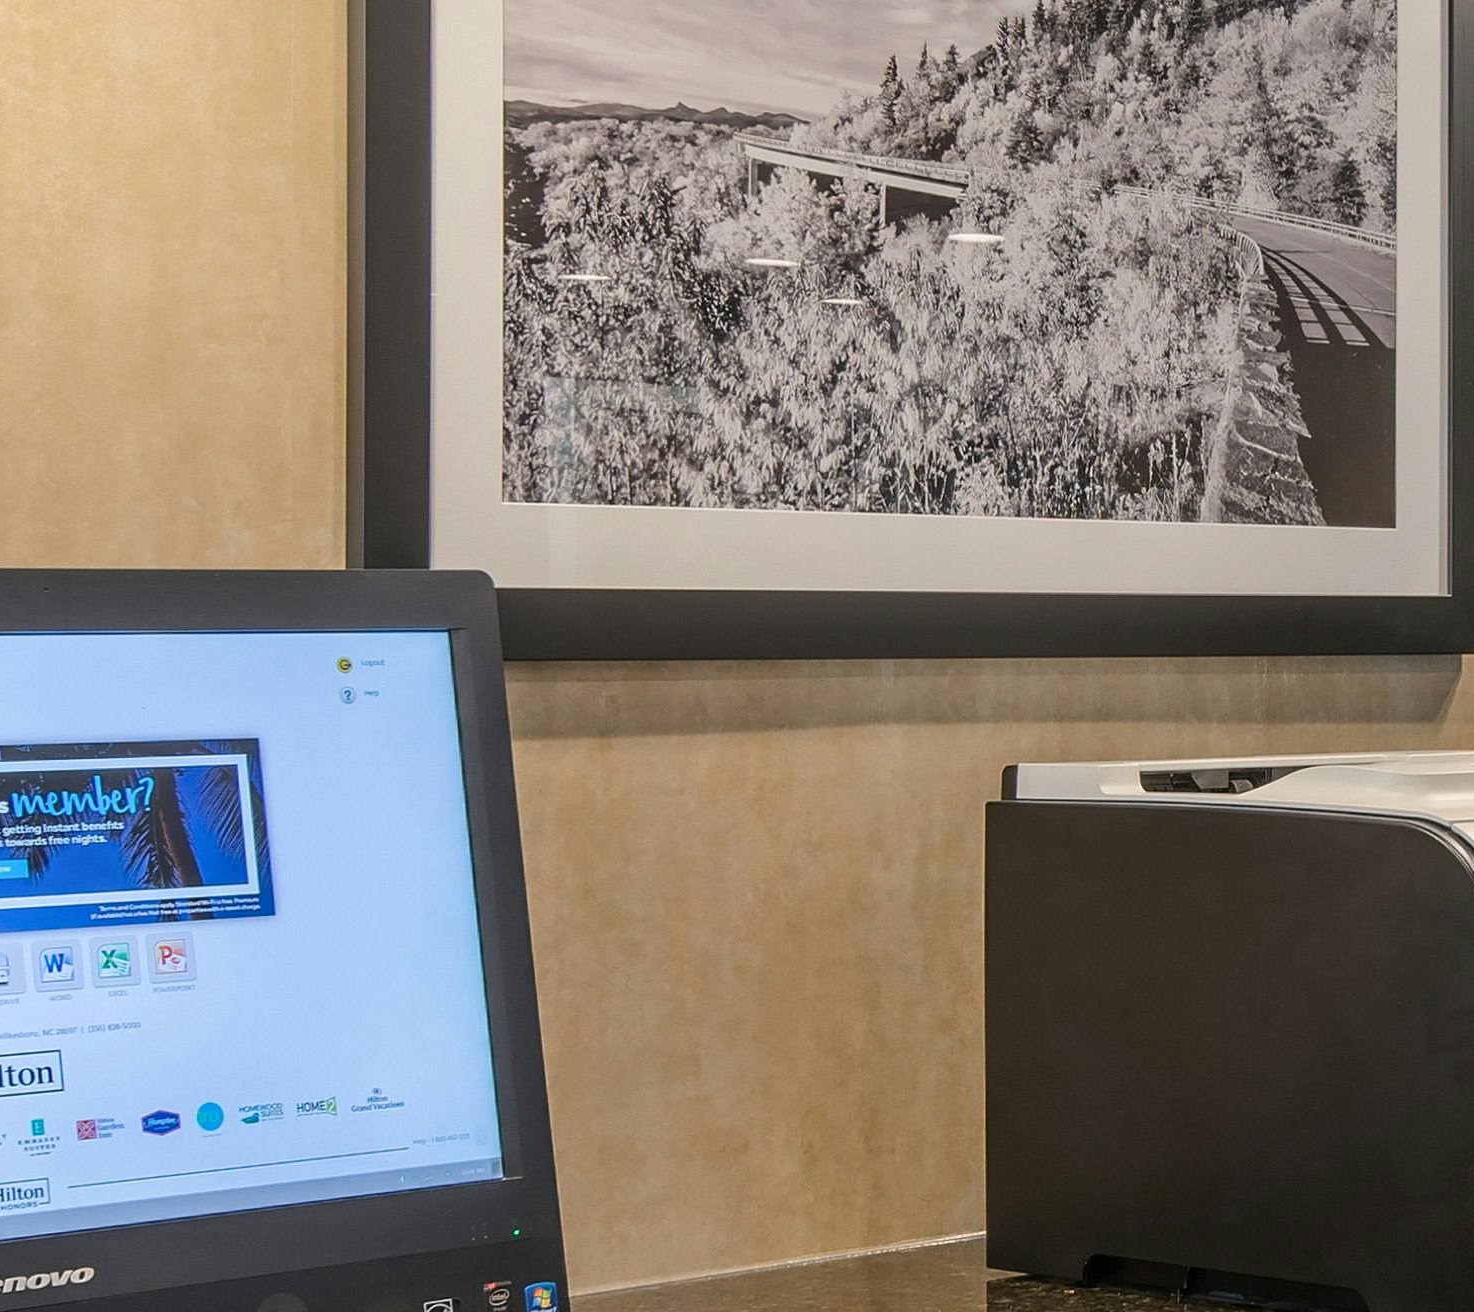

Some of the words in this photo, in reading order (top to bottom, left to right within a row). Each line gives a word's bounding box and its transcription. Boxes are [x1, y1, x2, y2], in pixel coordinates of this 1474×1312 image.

[11, 775, 154, 818] member?
[3, 824, 42, 837] getting
[43, 822, 80, 833] instant
[81, 820, 125, 831] benefits
[5, 837, 47, 847] towards
[48, 836, 71, 845] free
[72, 834, 108, 846] nights.
[0, 1201, 38, 1211] HONORS
